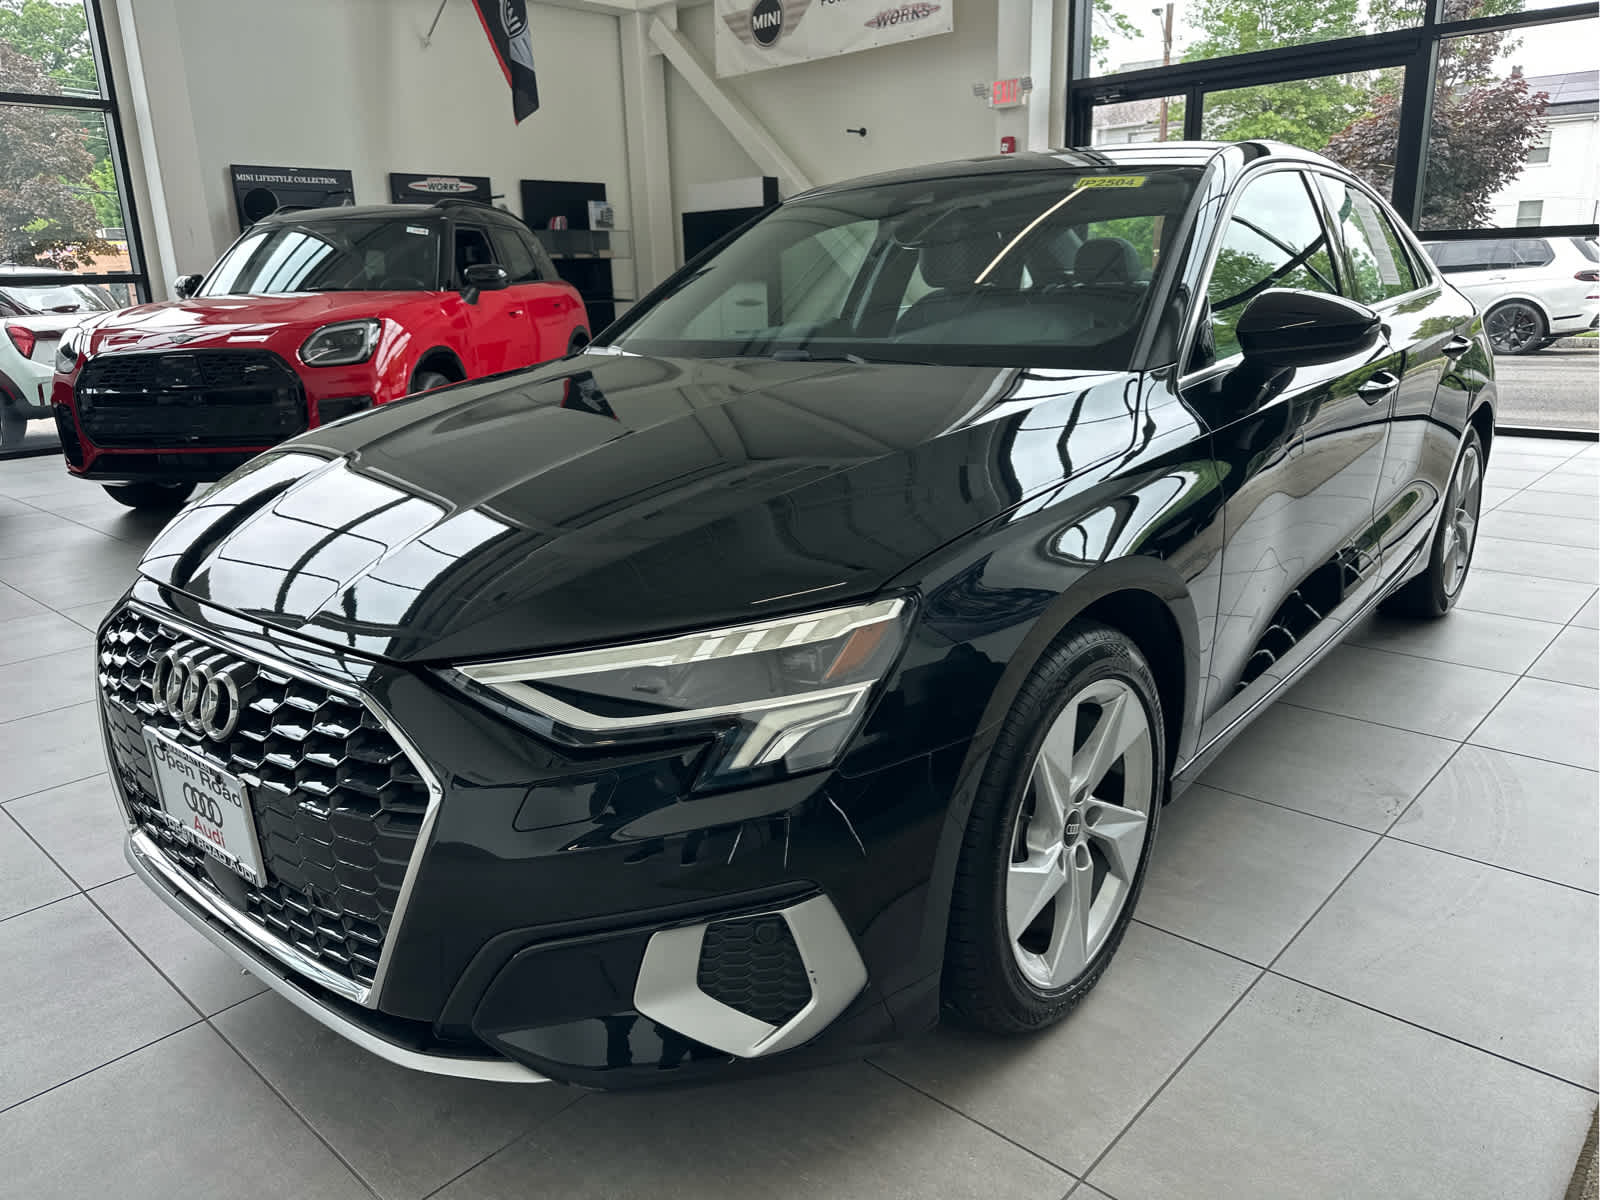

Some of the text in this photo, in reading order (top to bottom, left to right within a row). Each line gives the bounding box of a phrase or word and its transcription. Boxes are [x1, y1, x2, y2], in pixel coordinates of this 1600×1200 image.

[752, 10, 781, 31] MINI
[876, 7, 931, 28] WORKS
[993, 79, 1018, 104] EXIT
[235, 173, 254, 182] MINI
[255, 174, 294, 184] LIFESTYLE
[427, 182, 460, 191] WORKS
[153, 744, 196, 780] Open
[200, 770, 243, 808] Road
[194, 815, 226, 849] Audi
